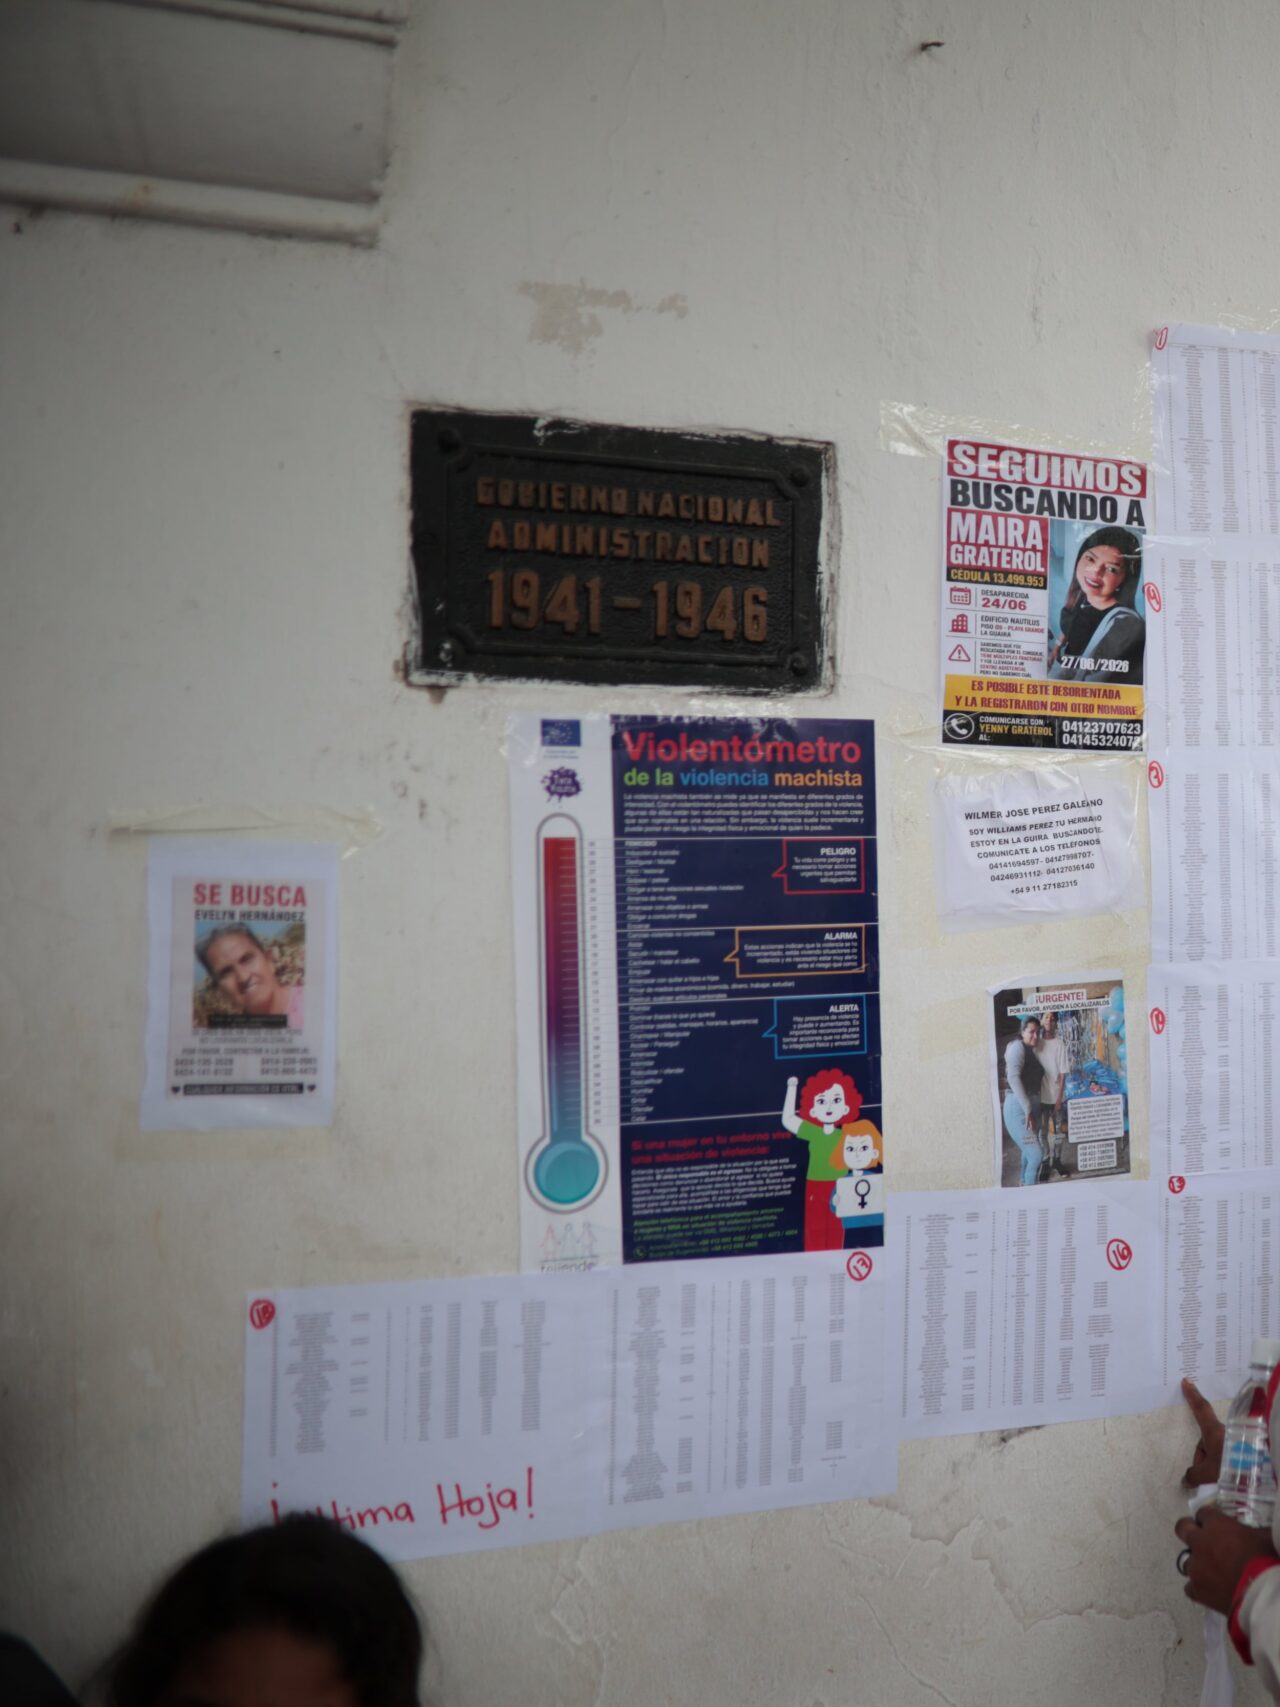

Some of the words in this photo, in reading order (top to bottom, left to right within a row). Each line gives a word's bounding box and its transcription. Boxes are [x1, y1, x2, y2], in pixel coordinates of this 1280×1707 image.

[953, 444, 1142, 496] SEGUIMOS
[476, 476, 628, 515] GOBIERNO
[637, 490, 783, 527] NACIONAL
[950, 478, 1118, 524] BUSCANDO
[1126, 499, 1145, 527] A
[951, 511, 1043, 550] MAIRA
[951, 544, 1045, 572] GRATEROL
[951, 568, 990, 582] CÉDULA
[993, 573, 1044, 587] 13.499.953
[981, 589, 1029, 599] DESAPARECIDA
[981, 597, 1027, 611] 24/06
[981, 615, 1009, 624] EDIFICIO
[1010, 617, 1040, 626] NAUTILUS
[1061, 655, 1129, 673] 27/06/2026
[971, 680, 983, 691] ES
[986, 681, 1024, 694] POSIBLE
[1027, 684, 1050, 695] ESTE
[1052, 685, 1121, 700] DESORIENTADA
[954, 695, 962, 706] Y
[965, 696, 977, 707] LA
[981, 696, 1047, 711] REGISTRARON
[1050, 701, 1068, 713] CON
[1071, 702, 1094, 714] OTRO
[1097, 703, 1137, 716] NOMBRE
[979, 715, 1029, 725] COMUNICARSE
[1030, 718, 1044, 726] CON
[1062, 719, 1141, 735] 04123707623
[979, 723, 1009, 733] YENNY
[1011, 725, 1053, 736] GRATEROL
[979, 733, 991, 741] AL:
[622, 732, 861, 763] Violentómetro
[623, 768, 649, 786] de
[656, 768, 674, 786] la
[680, 768, 769, 786] violencia
[774, 770, 862, 786] machista
[965, 809, 1002, 820] WILMER
[1005, 807, 1030, 818] JOSE
[1032, 803, 1060, 815] PEREZ
[969, 828, 985, 836] SOY
[987, 824, 1027, 835] WILLIAMS
[1029, 821, 1053, 831] PEREZ
[1056, 819, 1065, 827] TU
[970, 839, 996, 848] ESTOY
[999, 837, 1009, 845] EN
[1012, 836, 1021, 844] LA
[1023, 833, 1049, 843] GUIRA
[820, 847, 856, 856] PELIGRO
[977, 847, 1030, 859] COMUNICATE
[1040, 844, 1055, 853] LOS
[194, 883, 222, 906] SE
[230, 884, 307, 908] BUSCA
[195, 909, 236, 921] EVELYN
[824, 932, 858, 941] ALARMA
[1036, 991, 1084, 1005] ¡URGENTE!
[1042, 1003, 1065, 1011] AYUDEN
[1070, 1000, 1110, 1009] LOCALIZARLOS
[829, 1003, 859, 1013] ALERTA
[437, 1466, 533, 1529] Hoja!
